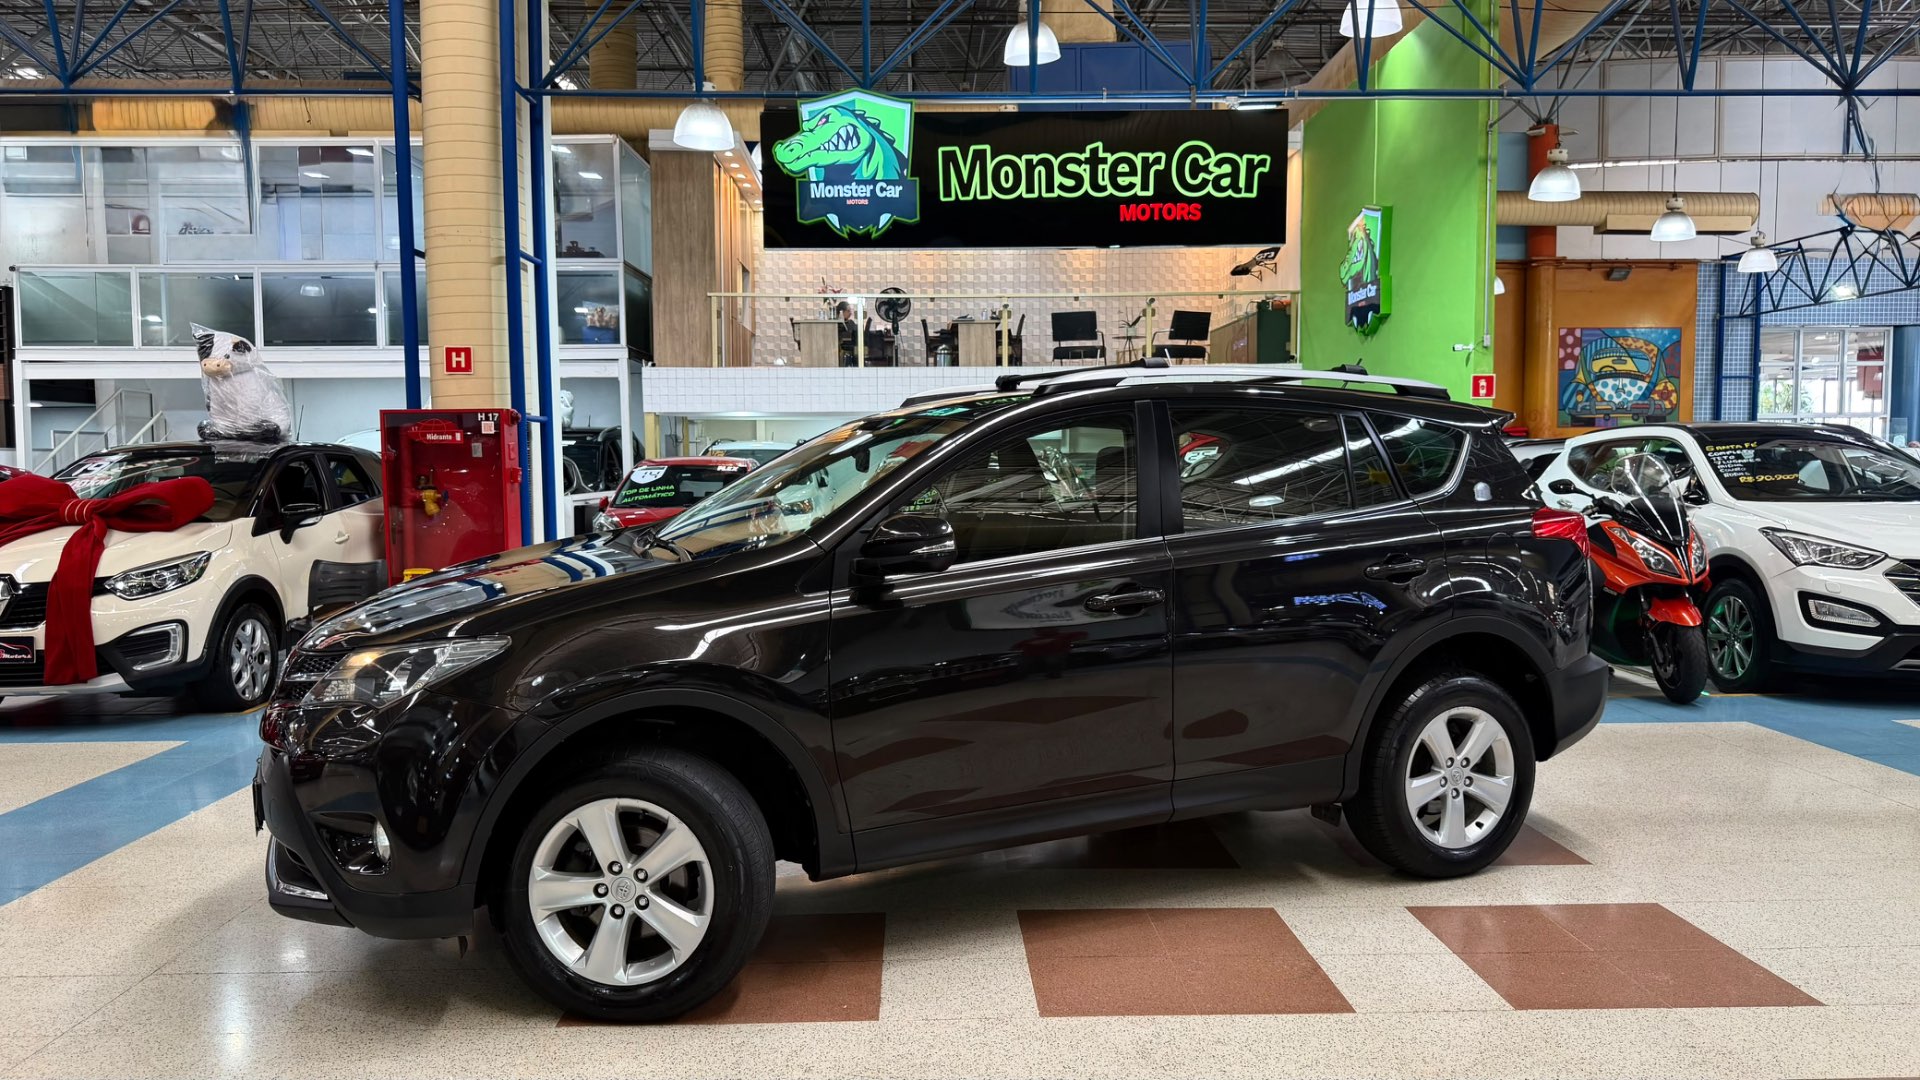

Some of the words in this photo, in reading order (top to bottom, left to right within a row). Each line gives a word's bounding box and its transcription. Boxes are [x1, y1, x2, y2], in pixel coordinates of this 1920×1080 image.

[938, 141, 1166, 201] Monster
[1171, 140, 1271, 198] Car
[809, 182, 873, 199] Monster
[875, 181, 903, 198] Car
[1119, 203, 1202, 222] MOTORS
[451, 351, 466, 368] H
[477, 412, 486, 421] H
[487, 412, 499, 421] 17
[426, 433, 452, 441] Hidrante
[622, 488, 638, 496] TOP
[651, 484, 675, 492] LINHA
[622, 492, 675, 503] AUTOMÁTICO
